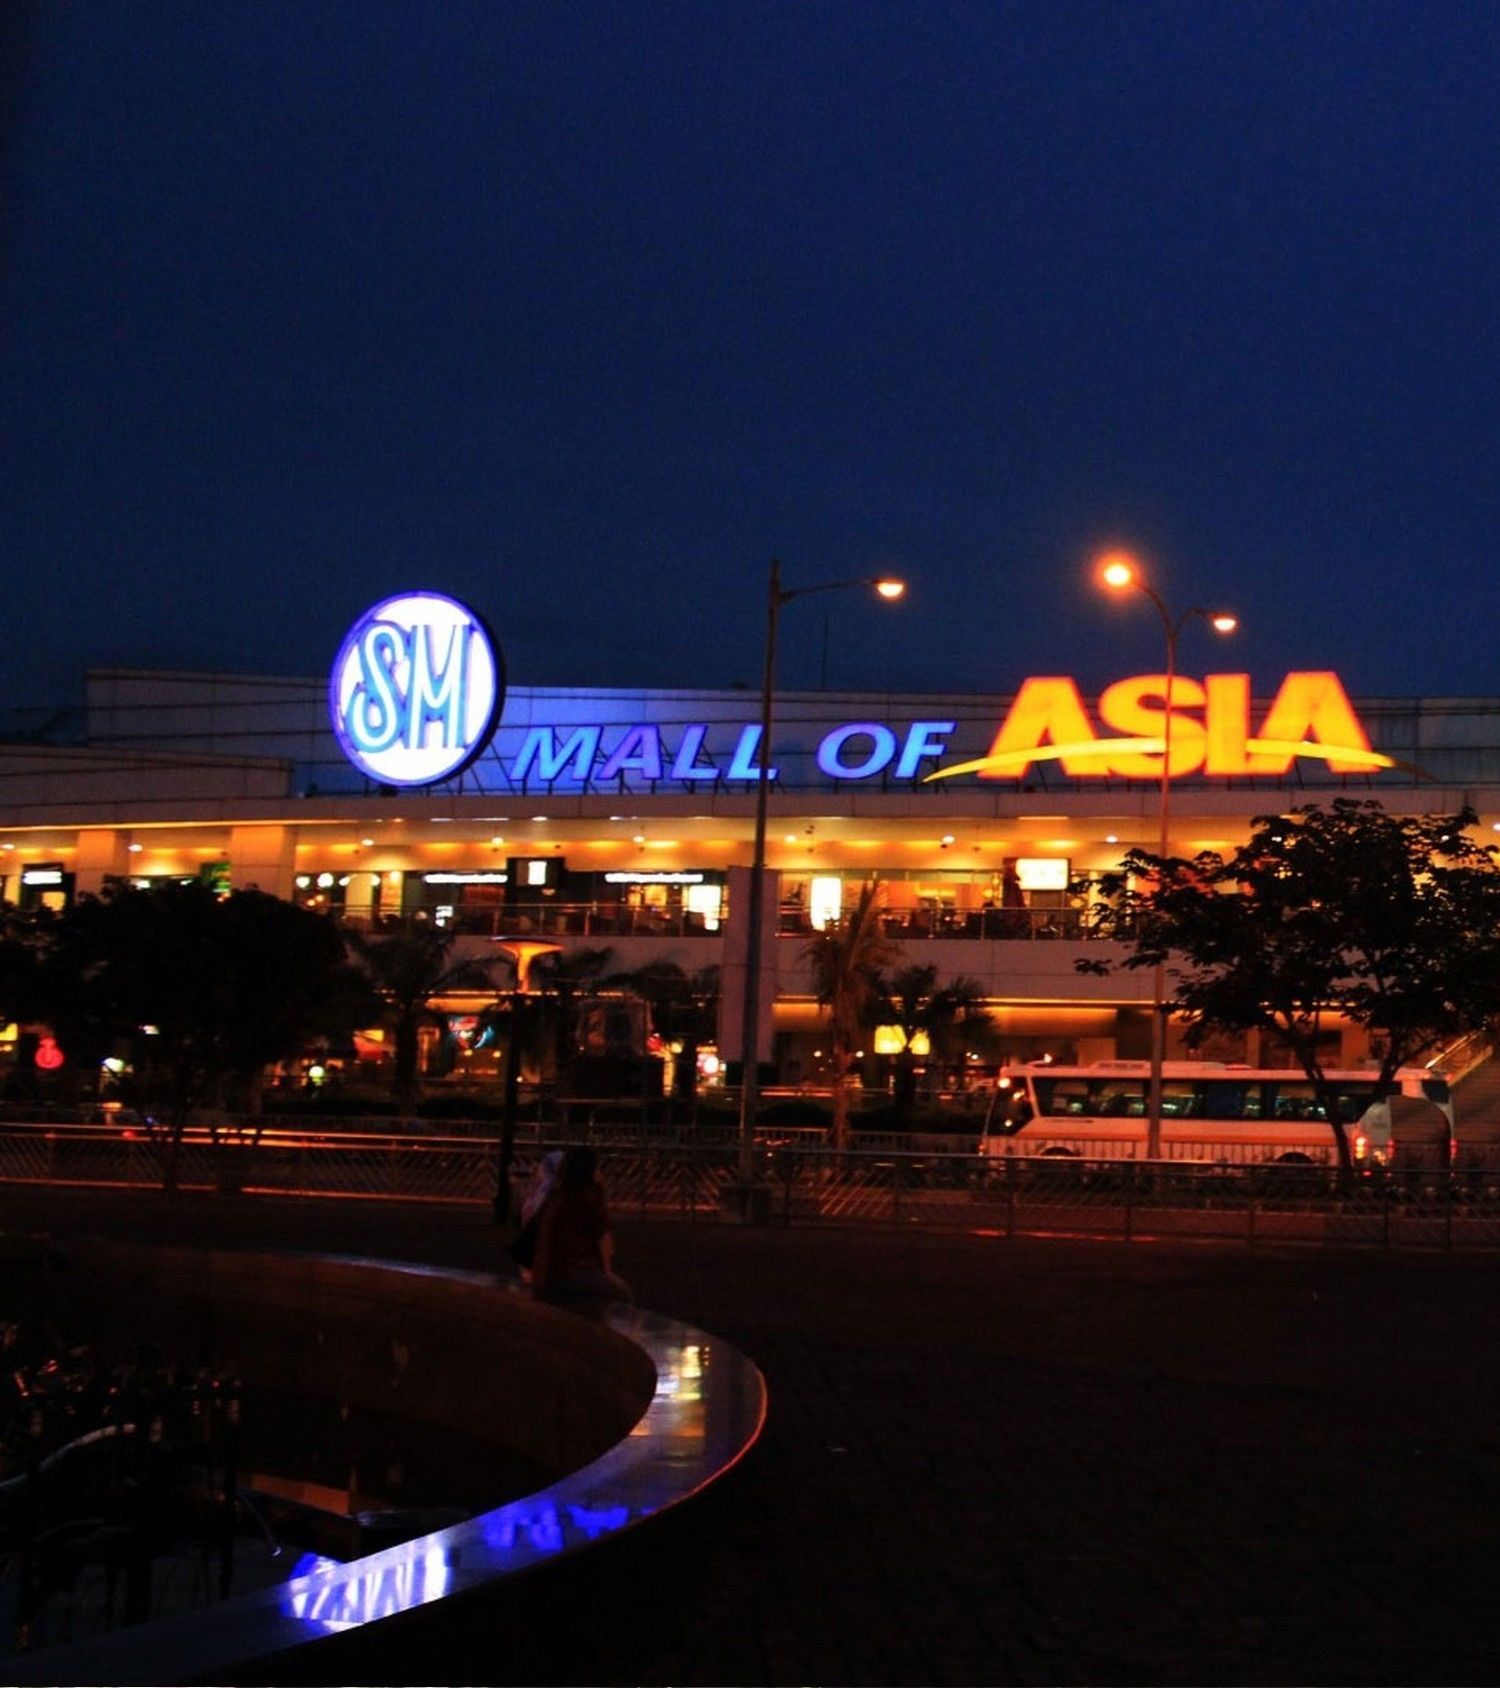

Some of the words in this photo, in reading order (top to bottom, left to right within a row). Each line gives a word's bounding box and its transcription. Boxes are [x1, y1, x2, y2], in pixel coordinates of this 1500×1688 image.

[343, 619, 473, 755] SM
[508, 722, 778, 782] MALL
[816, 721, 957, 780] OF
[976, 671, 1382, 780] ASIA
